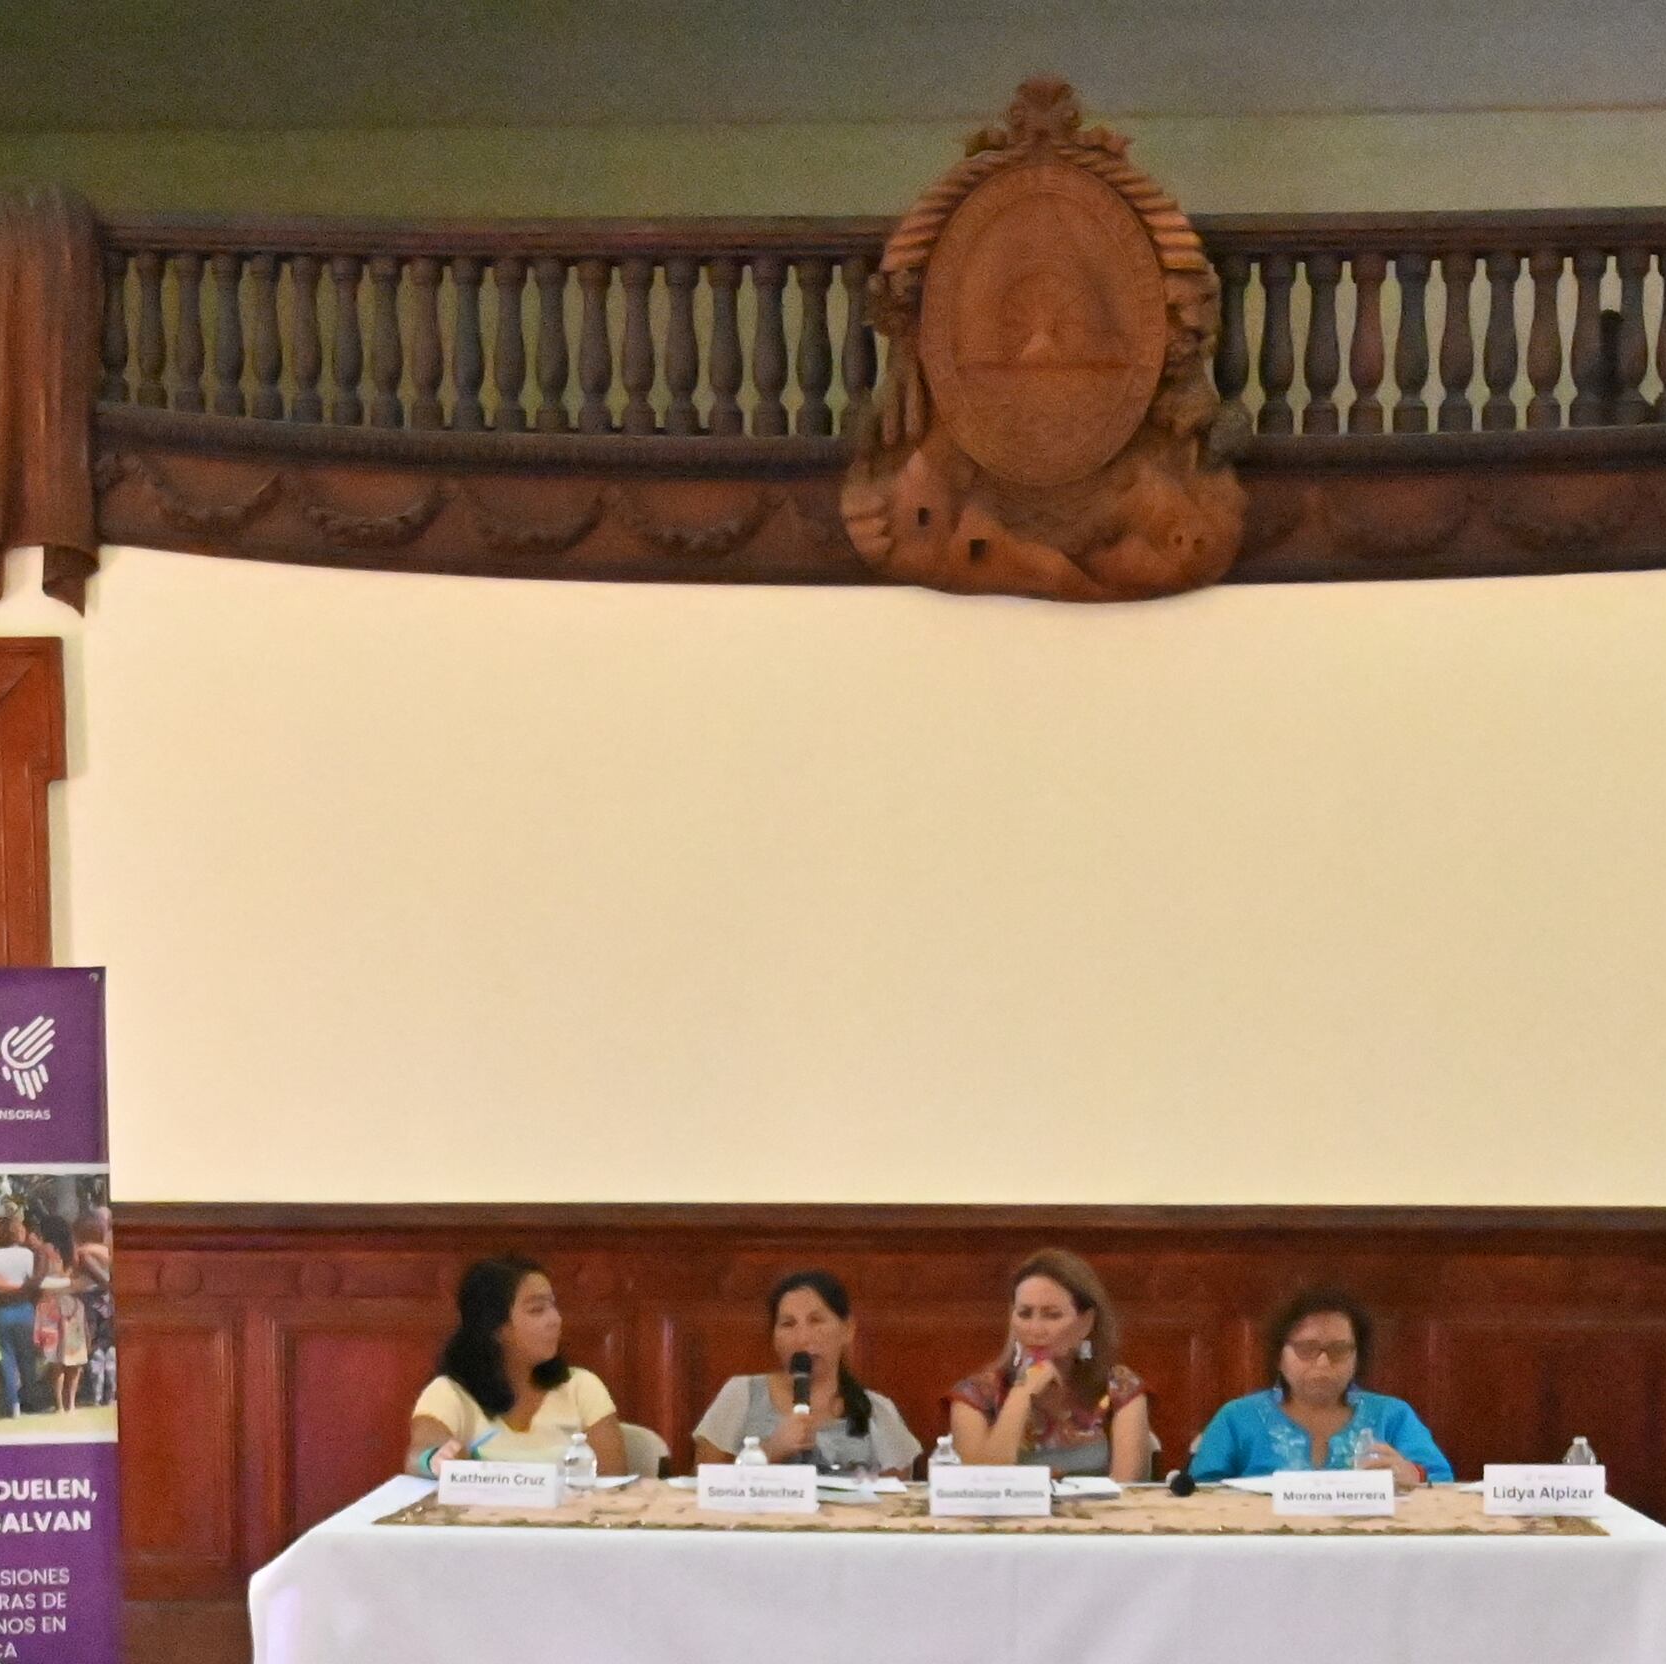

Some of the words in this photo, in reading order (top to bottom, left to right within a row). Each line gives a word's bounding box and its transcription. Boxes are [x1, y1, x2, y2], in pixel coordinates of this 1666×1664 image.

[450, 1472, 510, 1485] Katherin
[514, 1474, 545, 1486] Cruz
[1283, 1491, 1332, 1501] Morena
[1336, 1490, 1386, 1501] Herrera
[1493, 1486, 1535, 1502] Lidya
[42, 1592, 67, 1610] DE
[42, 1616, 67, 1633] EN
